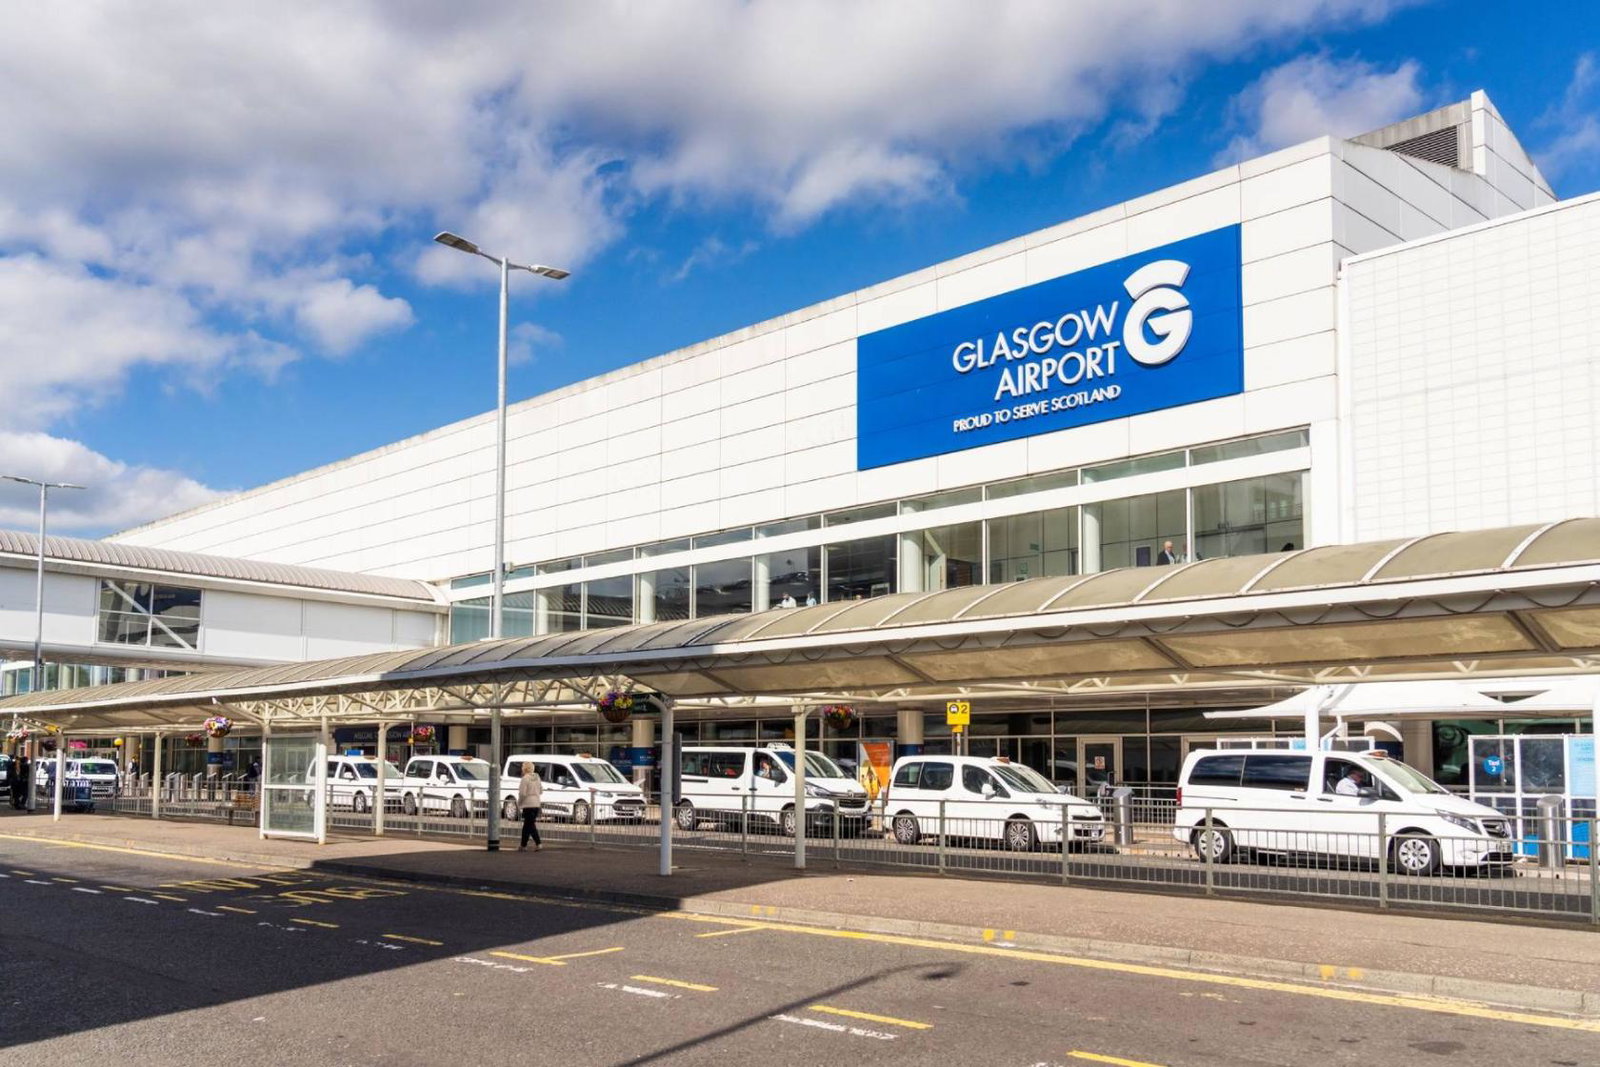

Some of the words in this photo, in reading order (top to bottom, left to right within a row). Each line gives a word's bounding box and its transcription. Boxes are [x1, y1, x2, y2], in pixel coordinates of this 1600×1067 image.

[952, 301, 1119, 373] GLASGOW
[1123, 285, 1193, 365] G
[994, 340, 1121, 401] AIRPORT
[952, 411, 992, 432] PROUD
[994, 408, 1012, 424] TO
[1013, 400, 1049, 421] SERVE
[1051, 384, 1122, 412] SCOTLAND
[961, 704, 968, 714] 2
